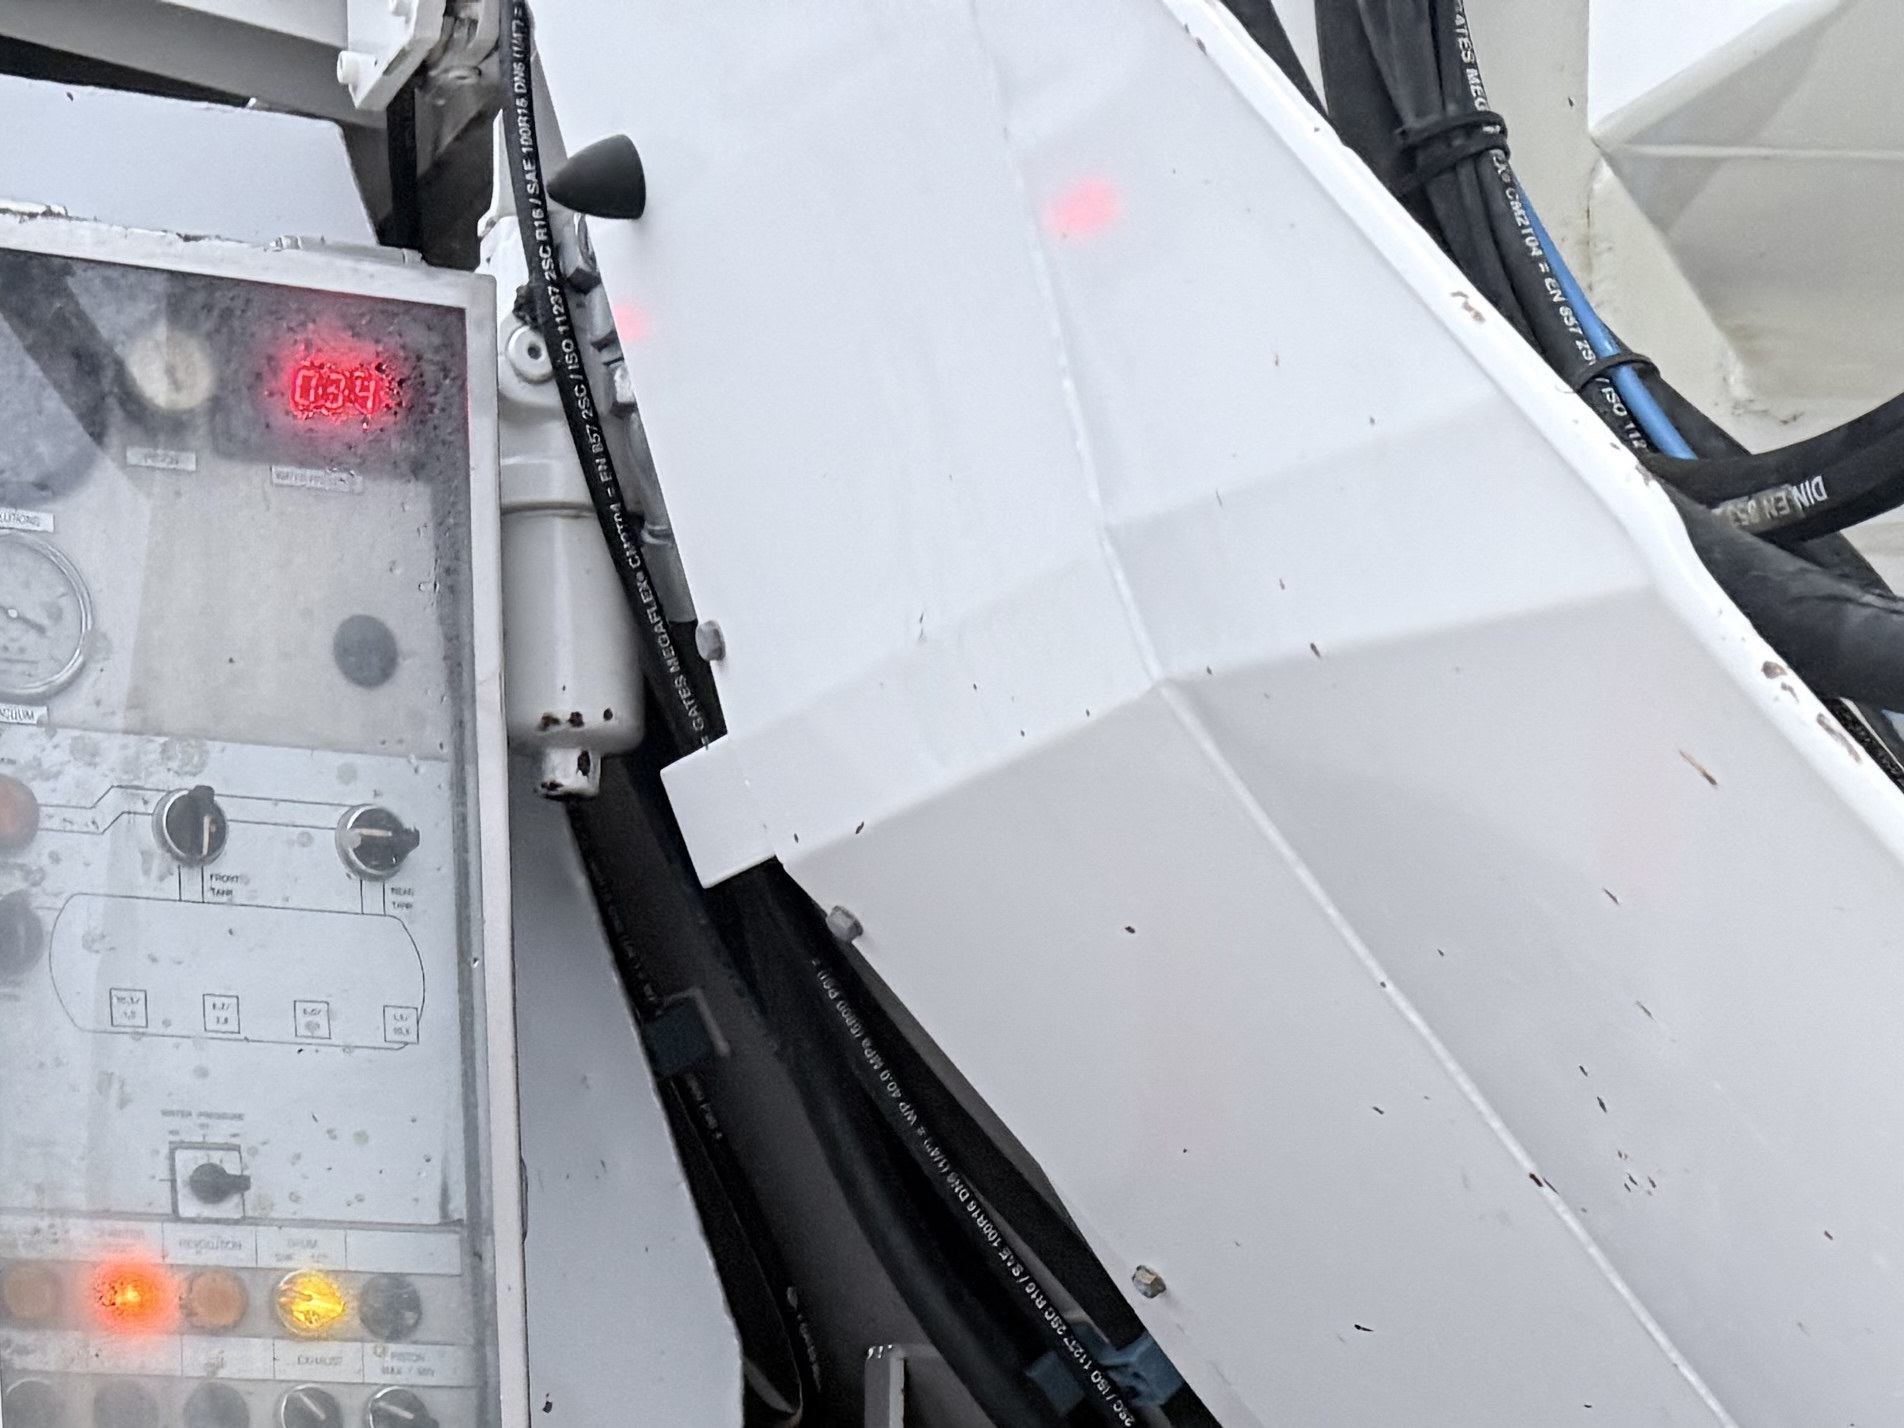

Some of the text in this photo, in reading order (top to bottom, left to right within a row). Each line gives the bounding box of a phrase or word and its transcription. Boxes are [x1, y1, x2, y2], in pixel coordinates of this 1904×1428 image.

[523, 158, 540, 195] SAE
[532, 210, 548, 240] R16
[539, 245, 558, 281] 2SC
[548, 285, 570, 334] 11237
[562, 339, 579, 370] ISO
[574, 384, 594, 420] 2SC
[1602, 385, 1627, 417] ISO
[1792, 475, 1829, 511] DIN
